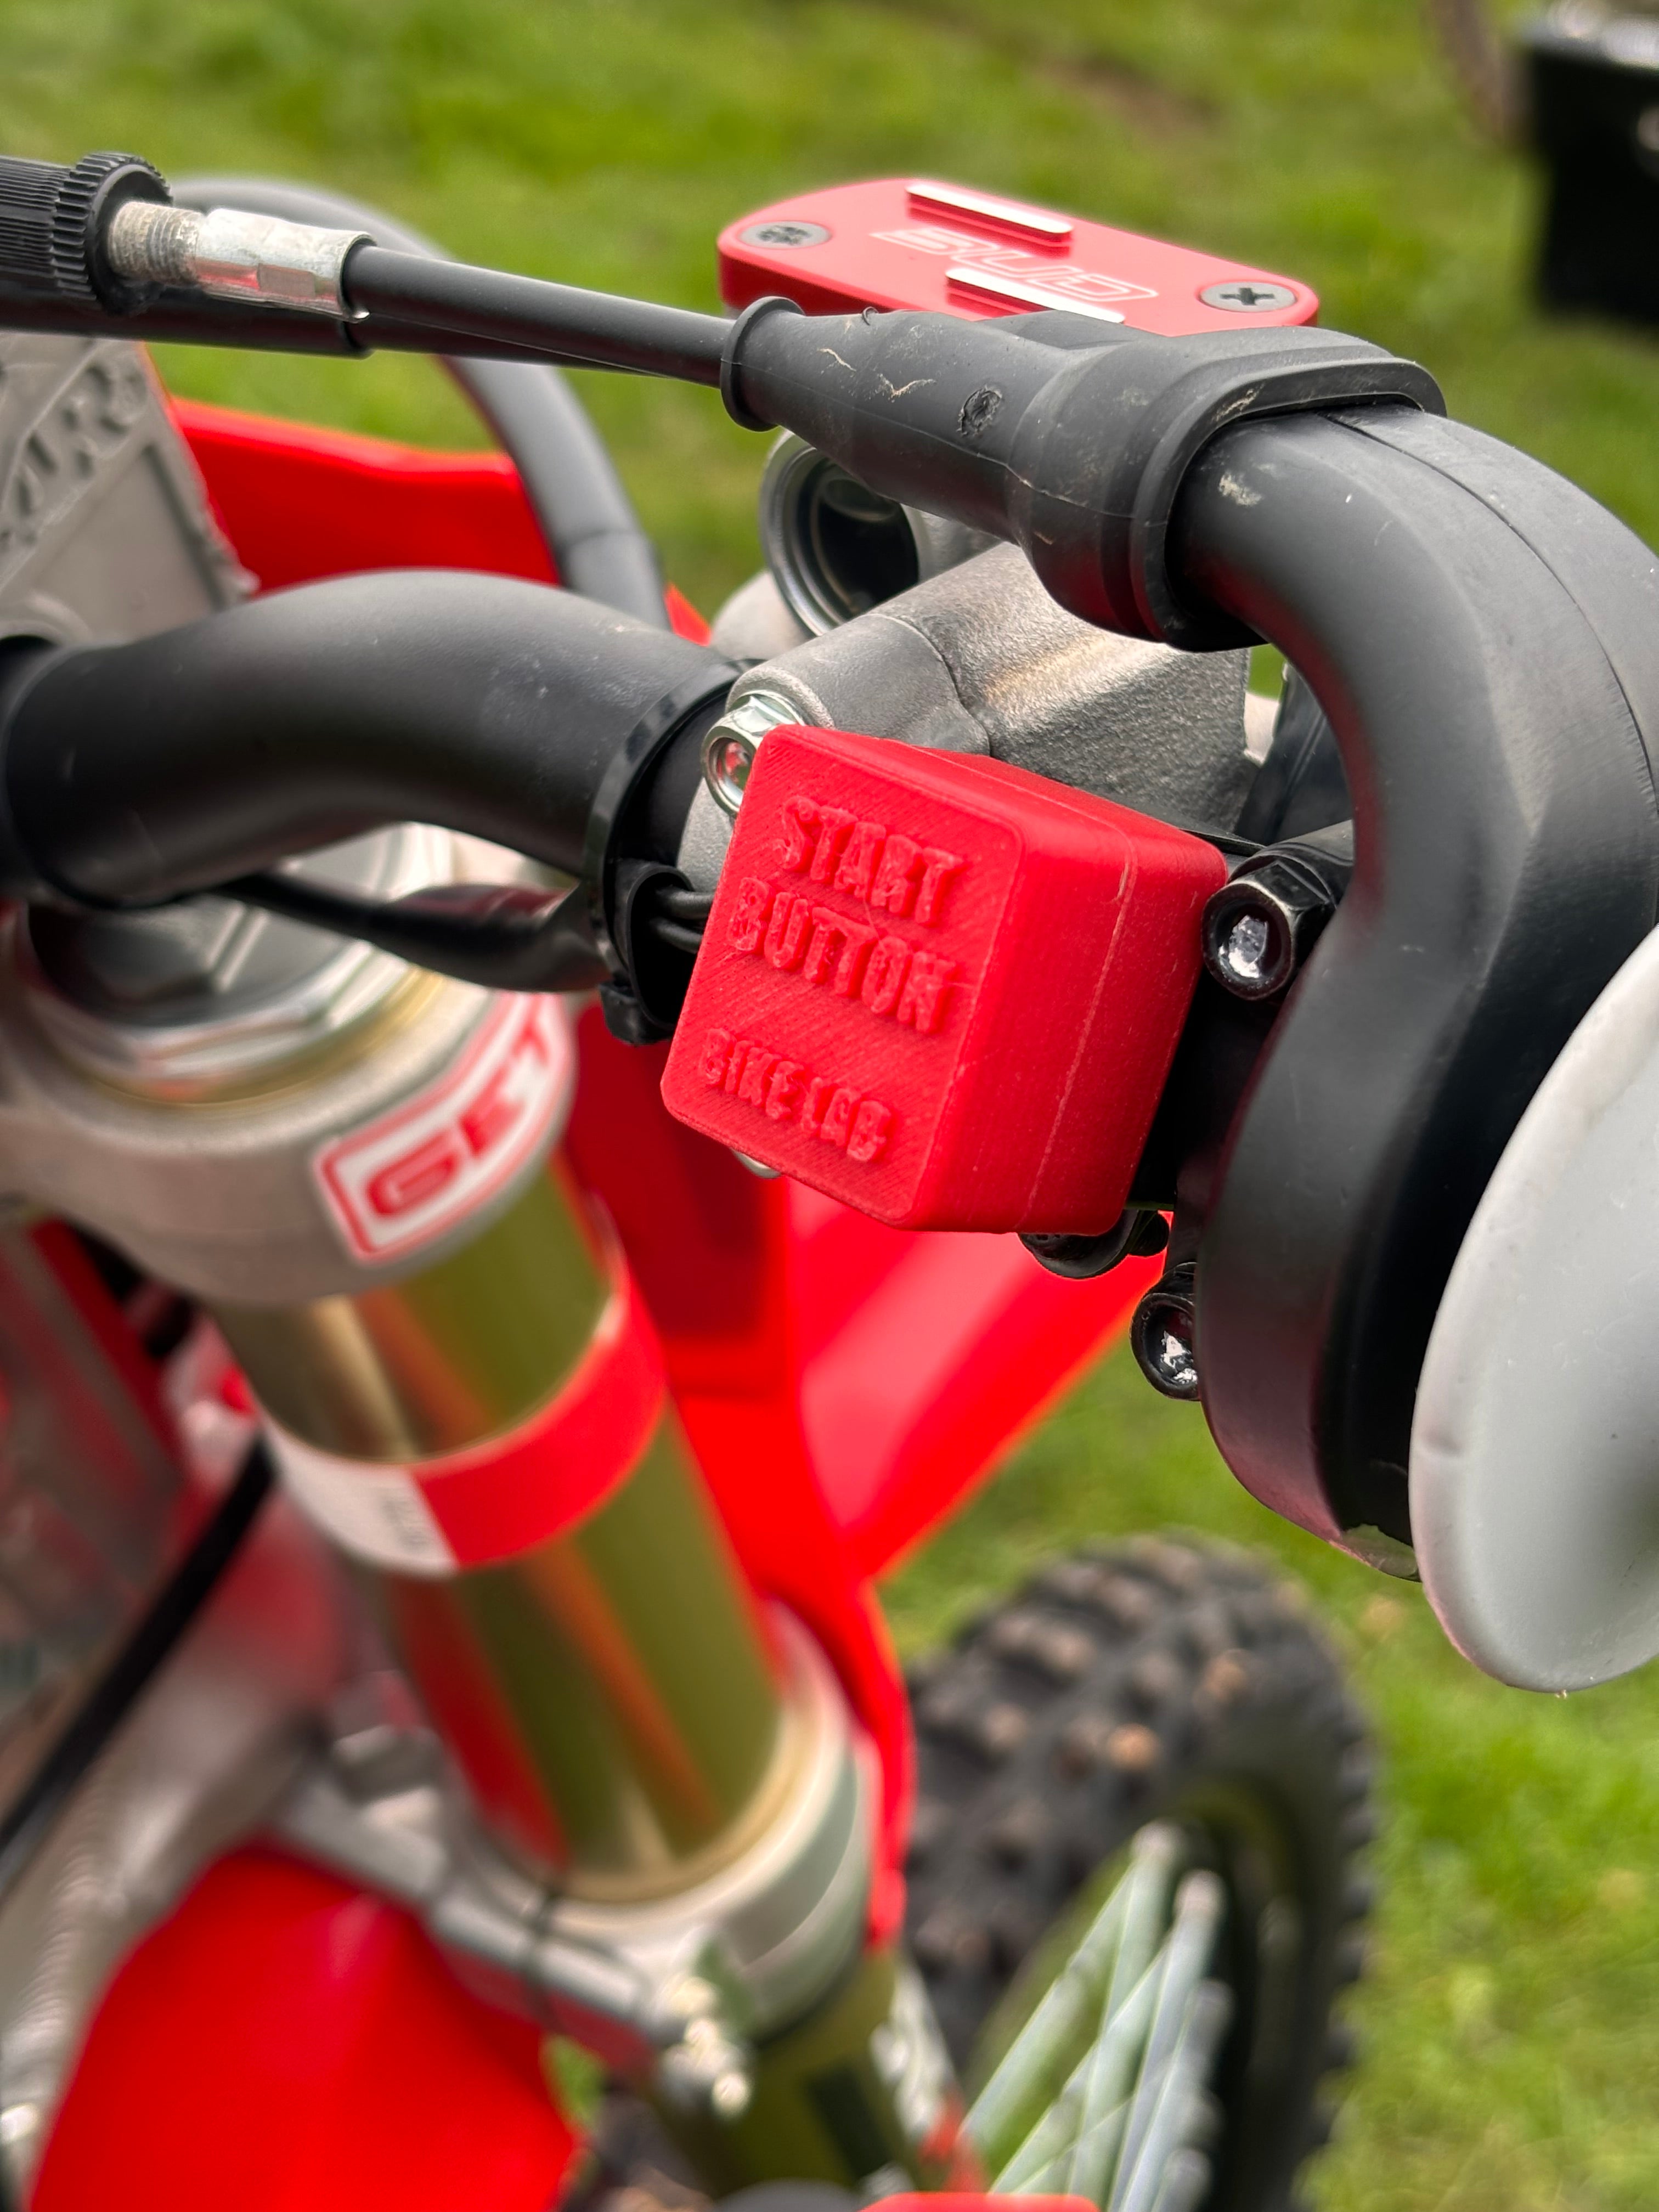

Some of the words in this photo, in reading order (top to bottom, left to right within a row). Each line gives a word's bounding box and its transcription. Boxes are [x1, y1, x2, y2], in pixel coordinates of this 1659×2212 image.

[773, 795, 964, 927] START
[729, 877, 956, 1032] BUTTON
[703, 1029, 805, 1120] BIKE
[800, 1076, 892, 1162] LAB
